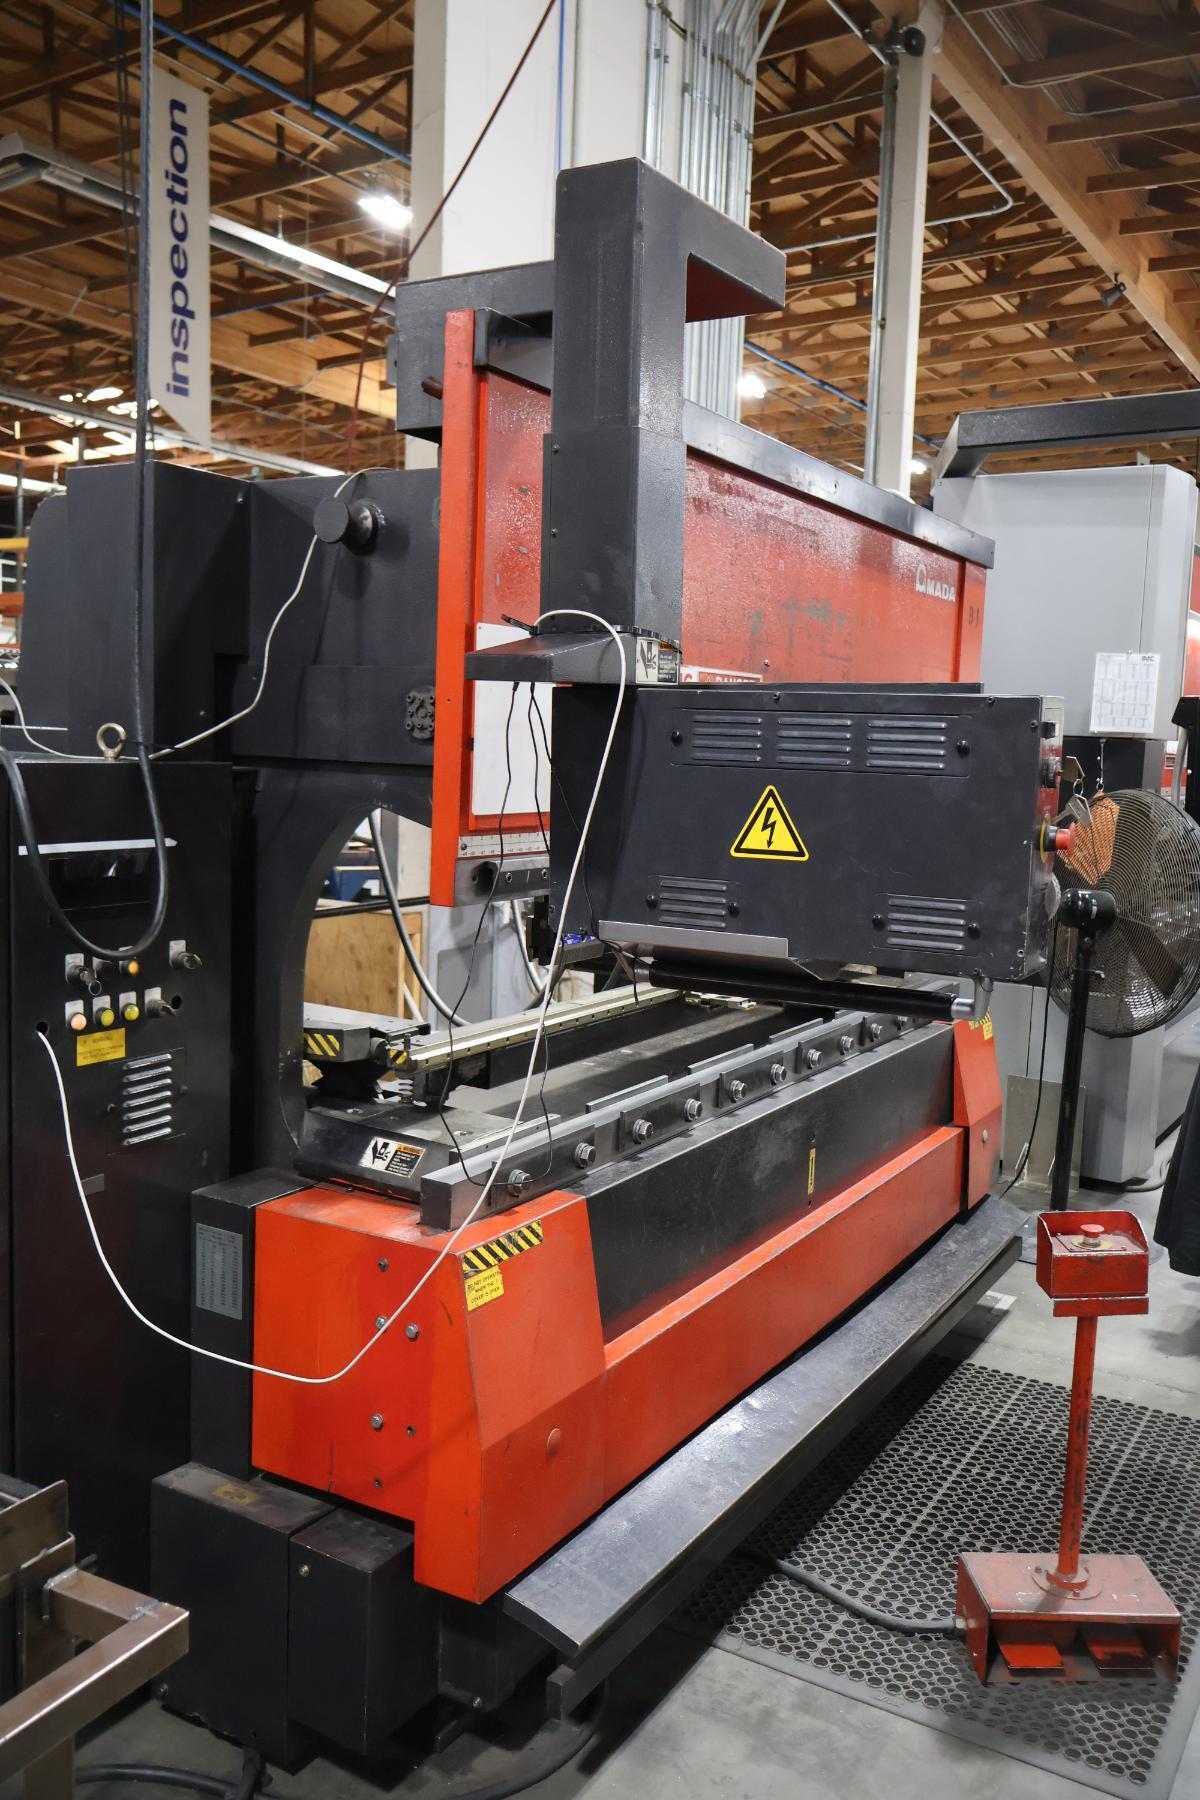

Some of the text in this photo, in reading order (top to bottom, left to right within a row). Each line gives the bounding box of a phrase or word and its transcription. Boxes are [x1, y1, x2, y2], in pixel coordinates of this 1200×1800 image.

[165, 98, 195, 397] inspection
[915, 563, 956, 602] AMADA
[471, 1294, 484, 1304] COVER
